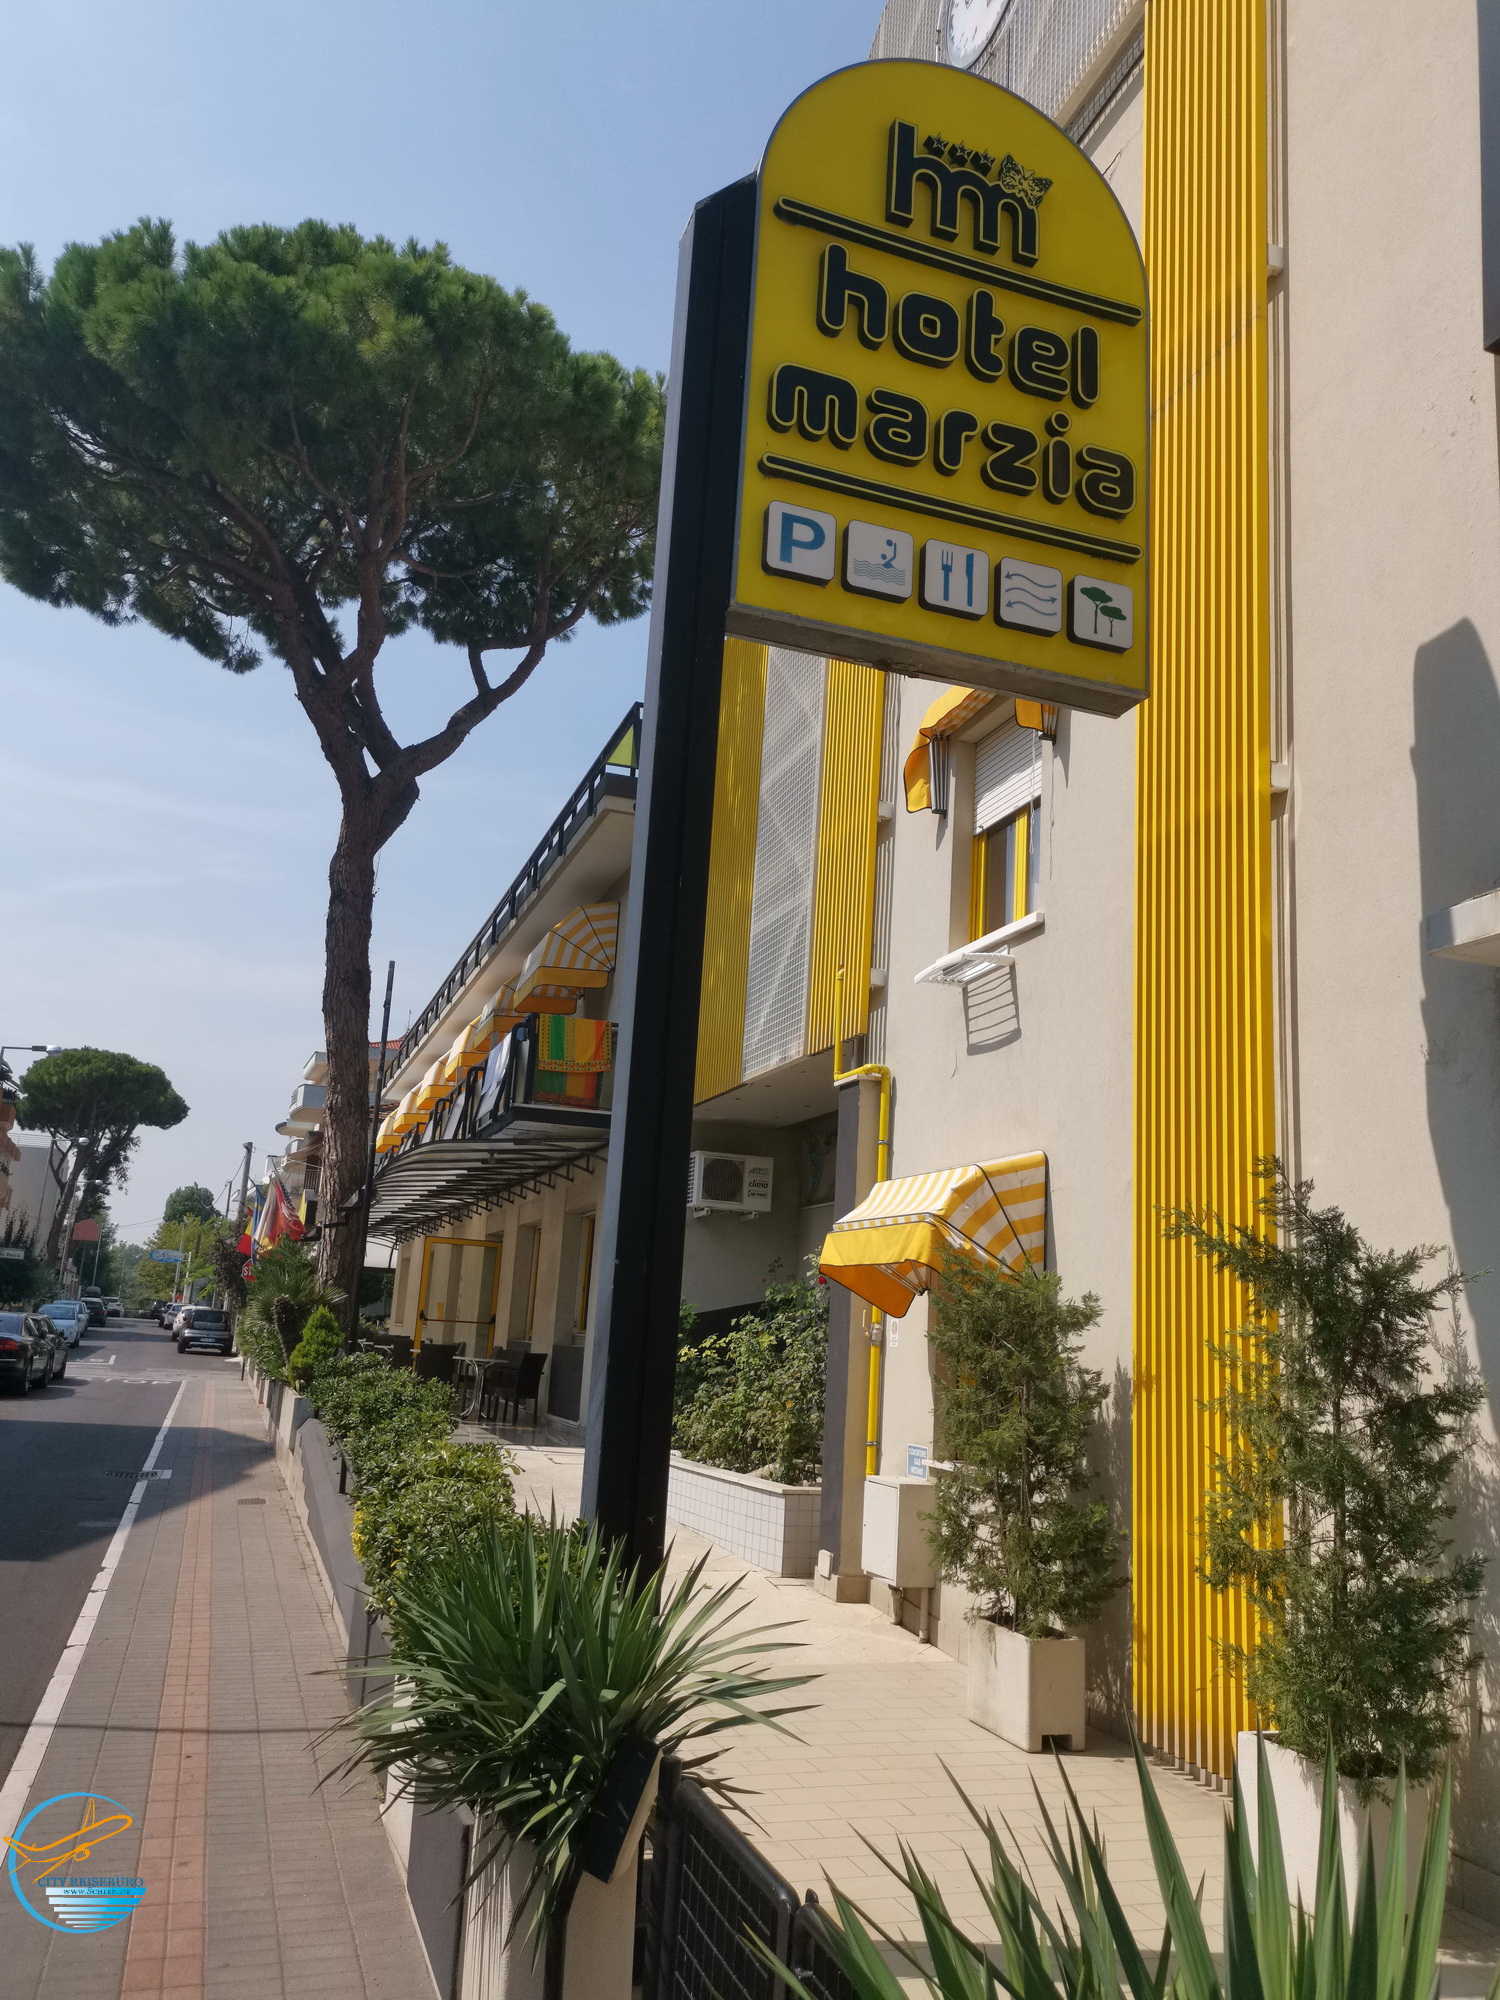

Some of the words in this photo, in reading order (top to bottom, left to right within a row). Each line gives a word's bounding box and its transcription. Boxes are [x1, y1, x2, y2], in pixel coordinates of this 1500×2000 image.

[816, 242, 1101, 409] hotel
[767, 360, 1137, 518] marzia
[779, 511, 826, 564] P
[748, 1180, 769, 1189] clima
[913, 1457, 921, 1465] GAS
